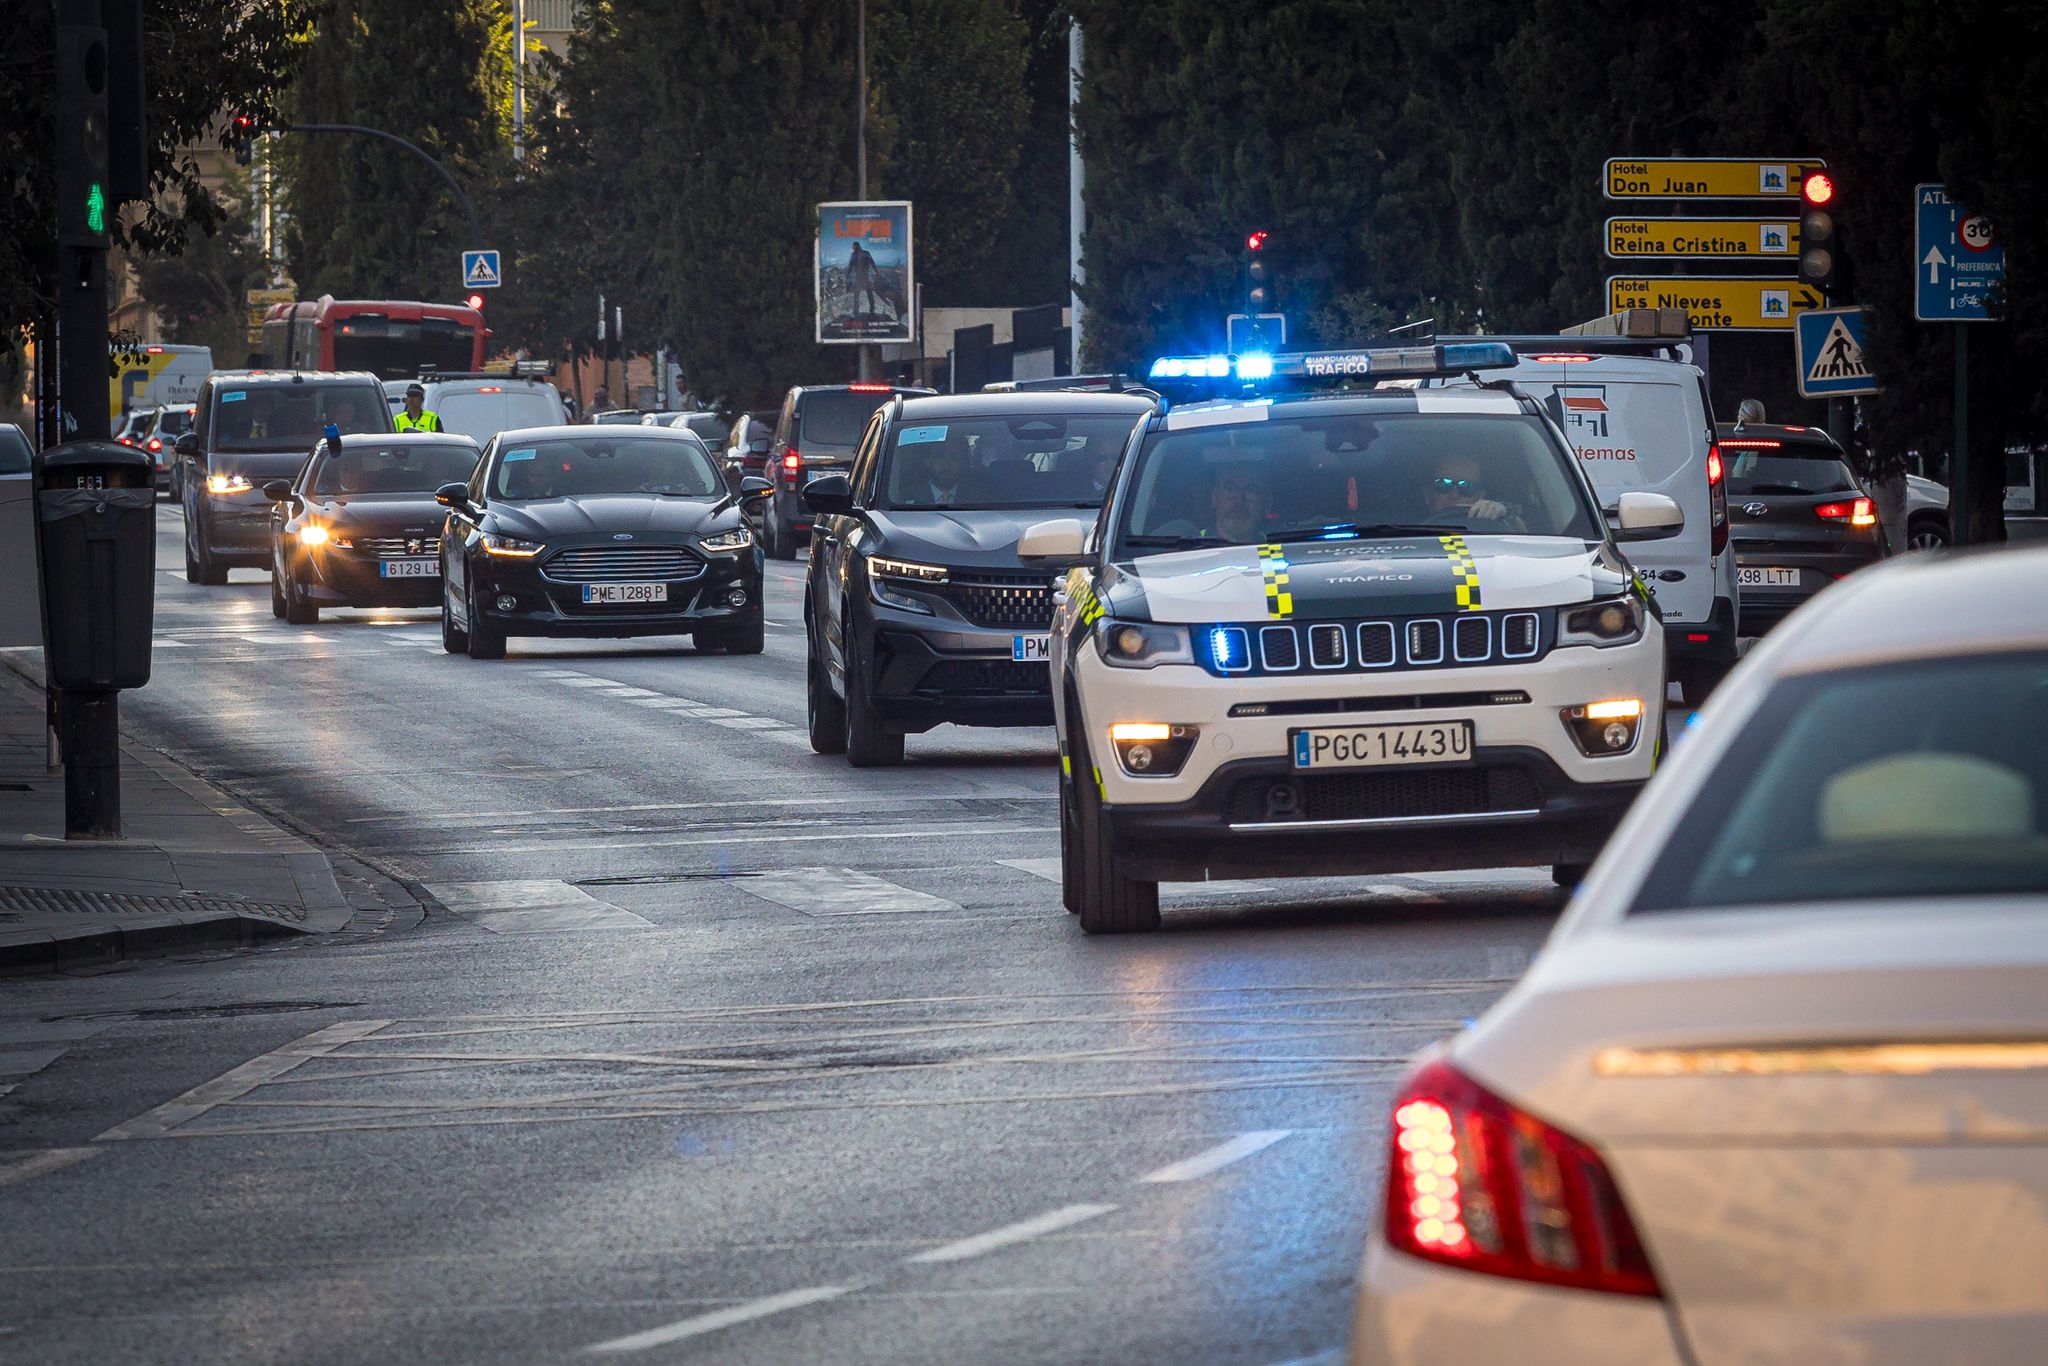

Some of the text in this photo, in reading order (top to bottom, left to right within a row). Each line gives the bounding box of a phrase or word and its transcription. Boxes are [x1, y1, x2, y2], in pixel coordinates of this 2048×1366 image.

[1613, 164, 1648, 175] Hotel
[1613, 178, 1708, 193] Don Juan
[1614, 223, 1649, 234] Hotel
[1614, 237, 1748, 252] Reina Cristina
[1615, 281, 1650, 292] Hotel
[1615, 294, 1722, 309] Las Nieves
[1305, 354, 1368, 364] GUARDIA CIVIL
[1306, 362, 1368, 376] TRAFICO
[1574, 445, 1636, 461] temas
[389, 563, 421, 575] 6129
[1640, 569, 1656, 581] 54
[1325, 574, 1413, 584] TRAFICO
[1767, 570, 1794, 584] LTT
[591, 585, 663, 600] PME 1288 P
[1648, 585, 1657, 596] 6
[1025, 638, 1049, 658] PM
[1314, 733, 1369, 762] PGC
